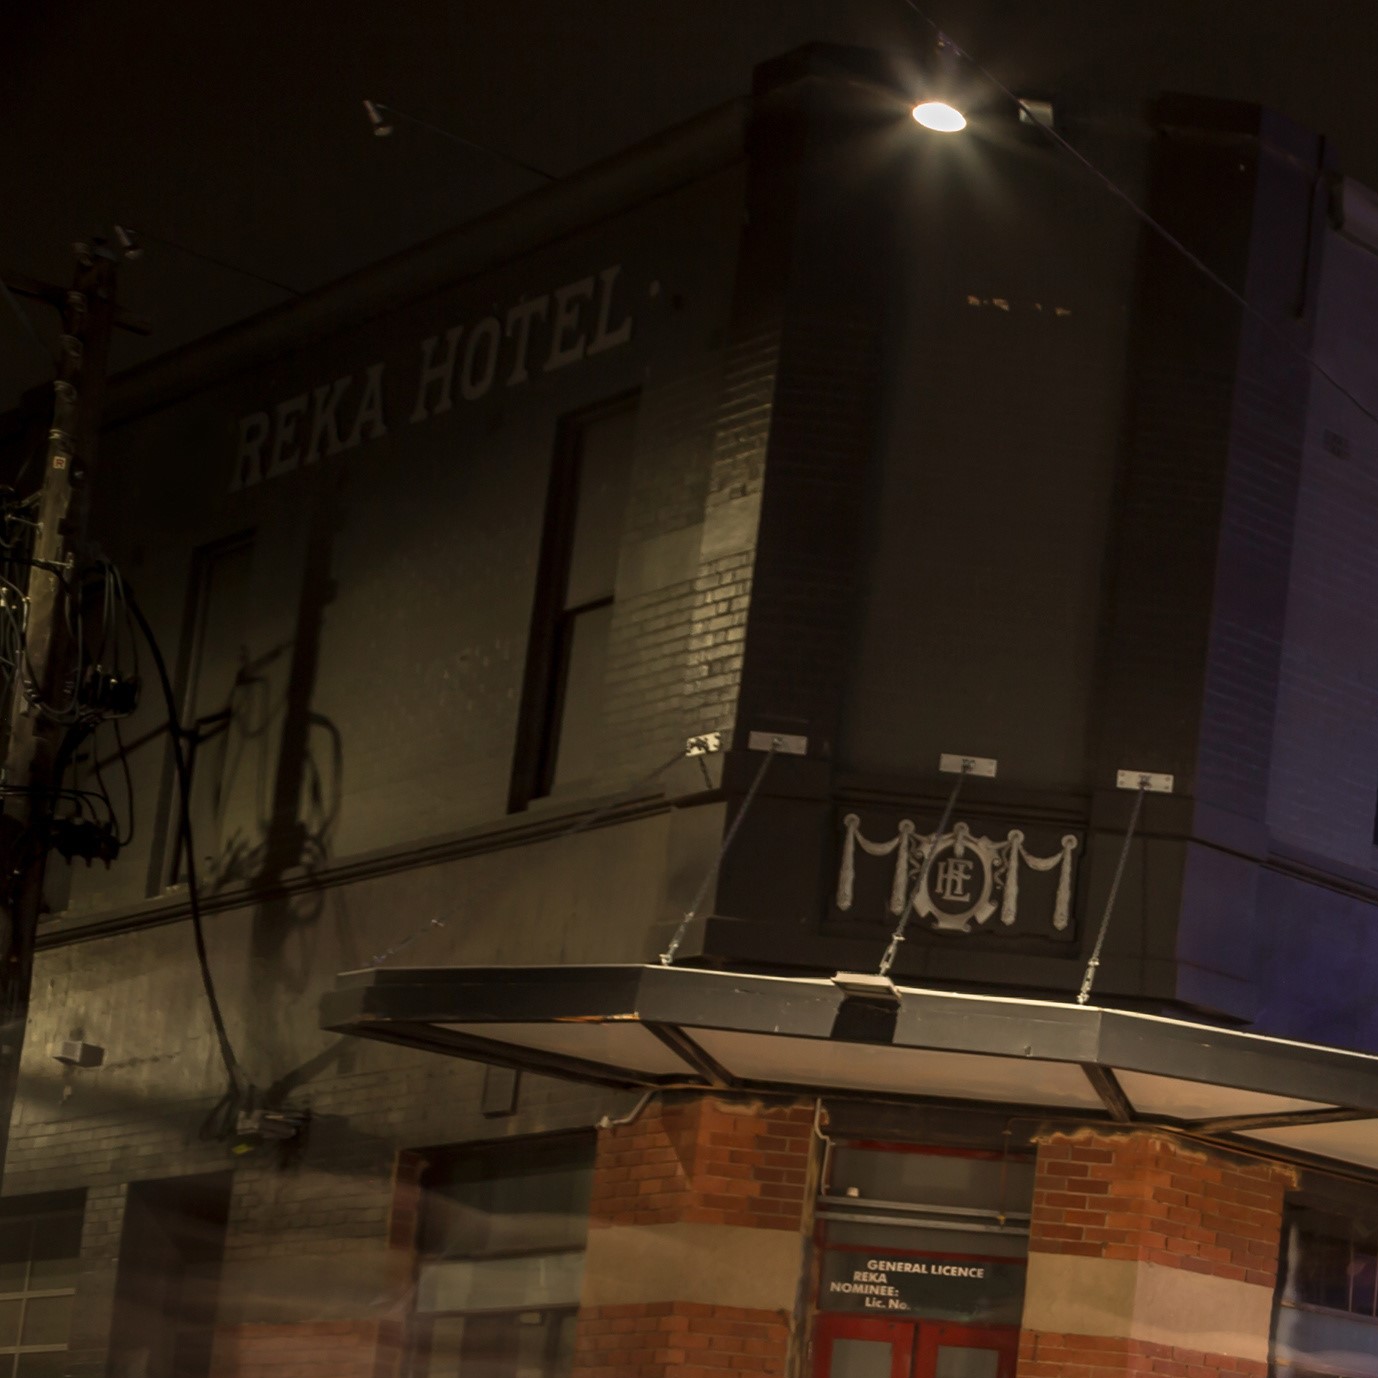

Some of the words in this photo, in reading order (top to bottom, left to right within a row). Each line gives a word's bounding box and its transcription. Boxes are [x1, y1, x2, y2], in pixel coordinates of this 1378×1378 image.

[227, 361, 388, 494] REKA
[853, 1270, 888, 1284] REKA
[867, 1259, 929, 1274] GENERAL
[931, 1264, 985, 1279] LICENCE
[829, 1281, 900, 1297] NOMINEE:
[864, 1296, 887, 1308] Lic.
